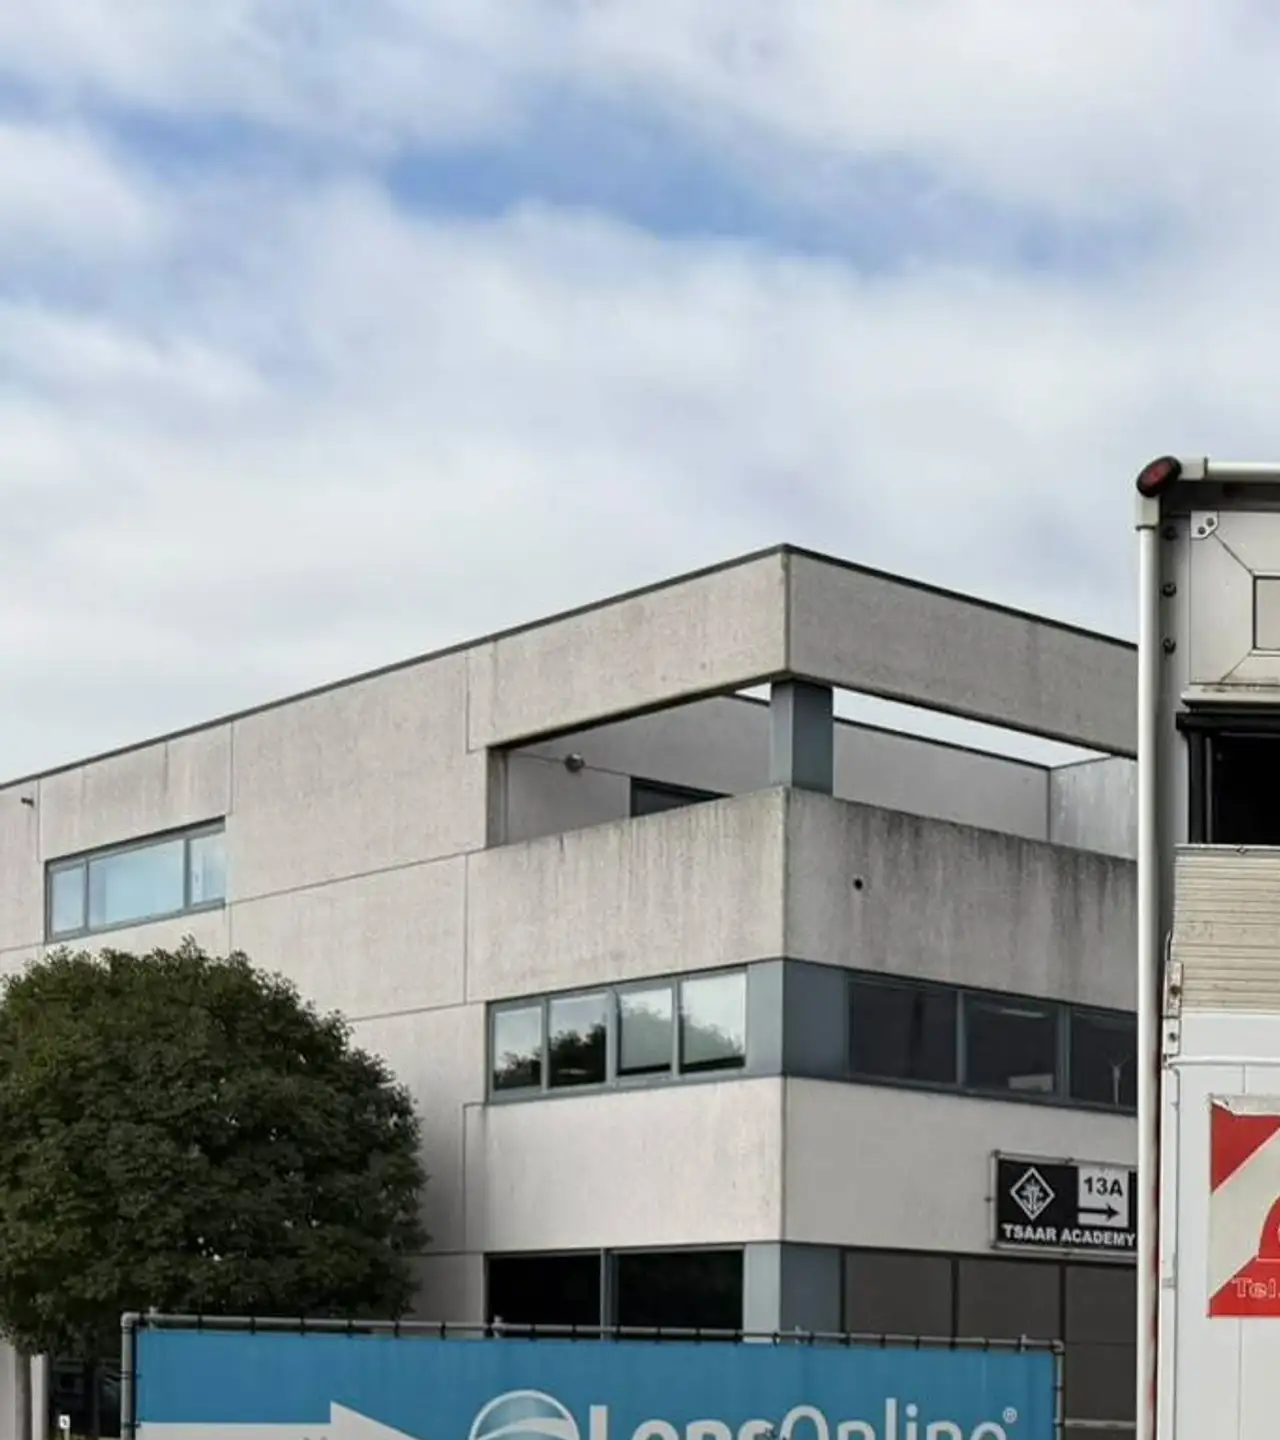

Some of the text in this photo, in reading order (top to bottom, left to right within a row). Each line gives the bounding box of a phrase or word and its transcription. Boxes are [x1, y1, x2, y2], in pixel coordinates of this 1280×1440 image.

[1083, 1176, 1124, 1198] 13A
[1001, 1223, 1136, 1247] TSAAR ACADEMY
